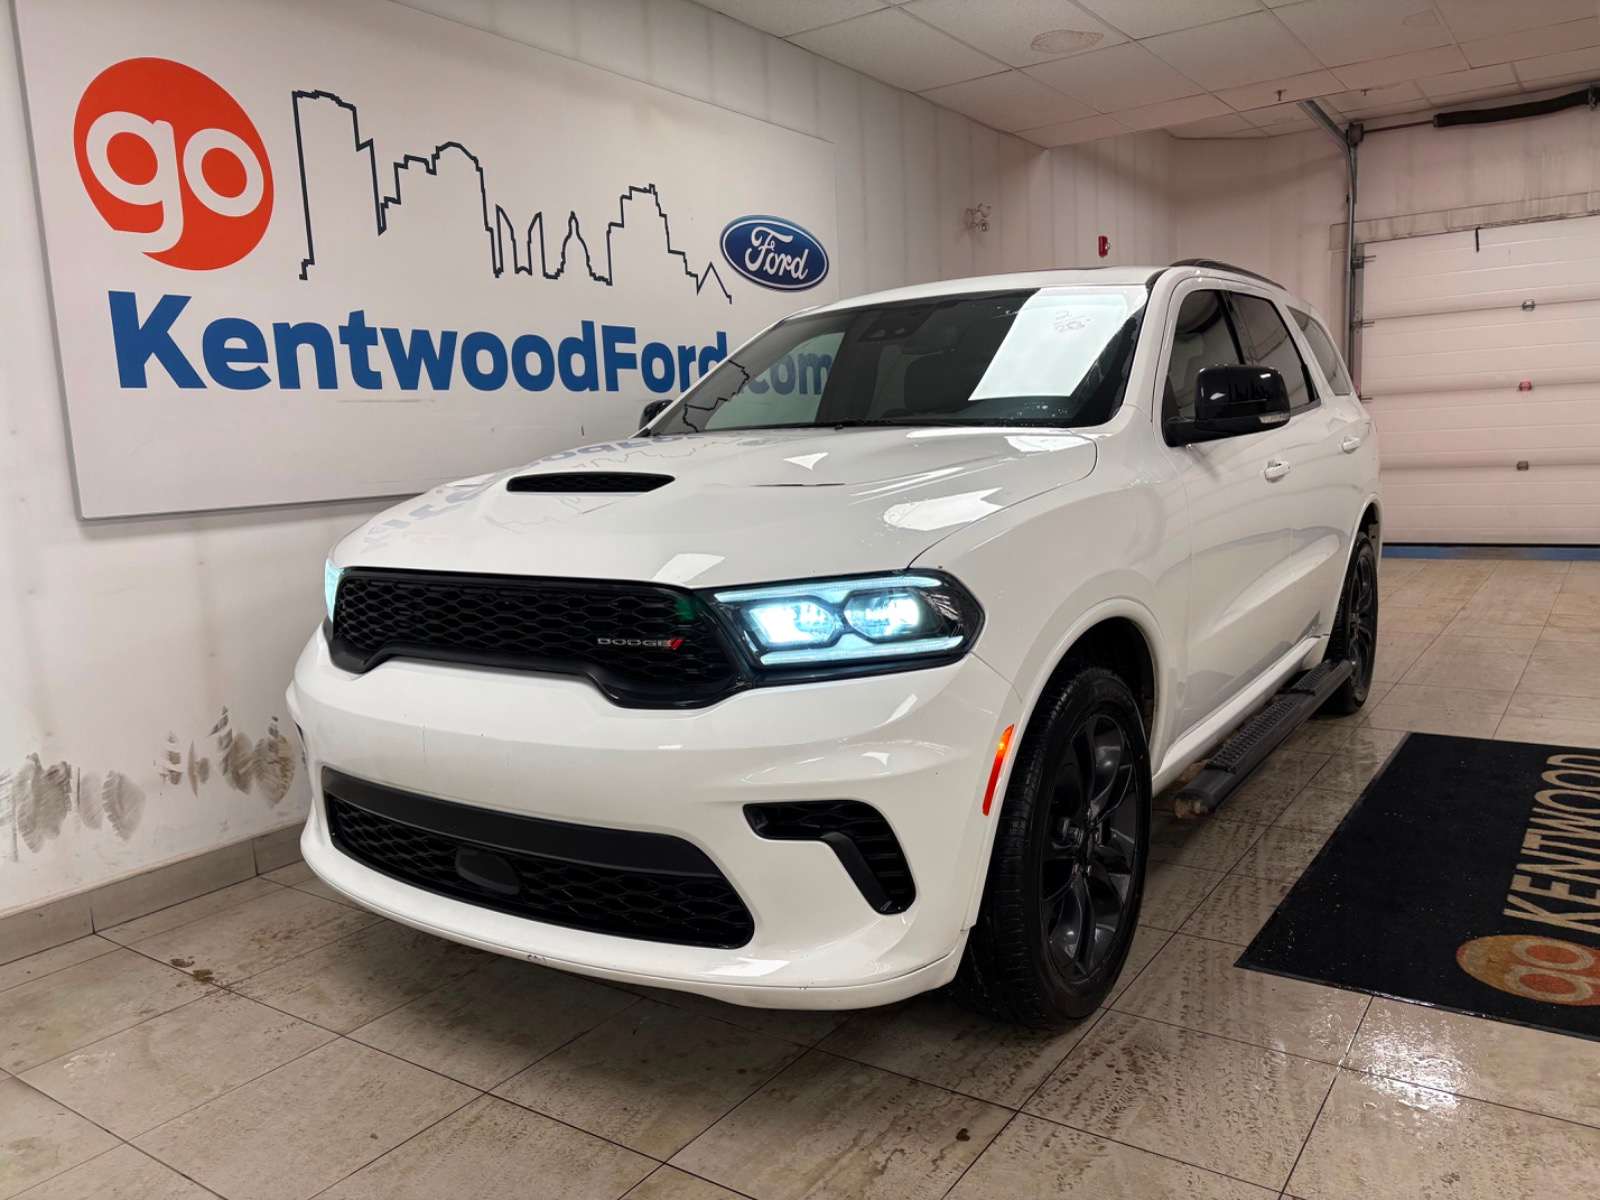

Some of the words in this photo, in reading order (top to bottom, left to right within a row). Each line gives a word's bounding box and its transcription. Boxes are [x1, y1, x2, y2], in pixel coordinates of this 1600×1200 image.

[86, 111, 264, 253] go
[744, 226, 808, 279] Ford
[108, 290, 832, 396] KentwoodFordom
[597, 637, 672, 648] DODGE
[1503, 754, 1600, 934] KENTWOOD
